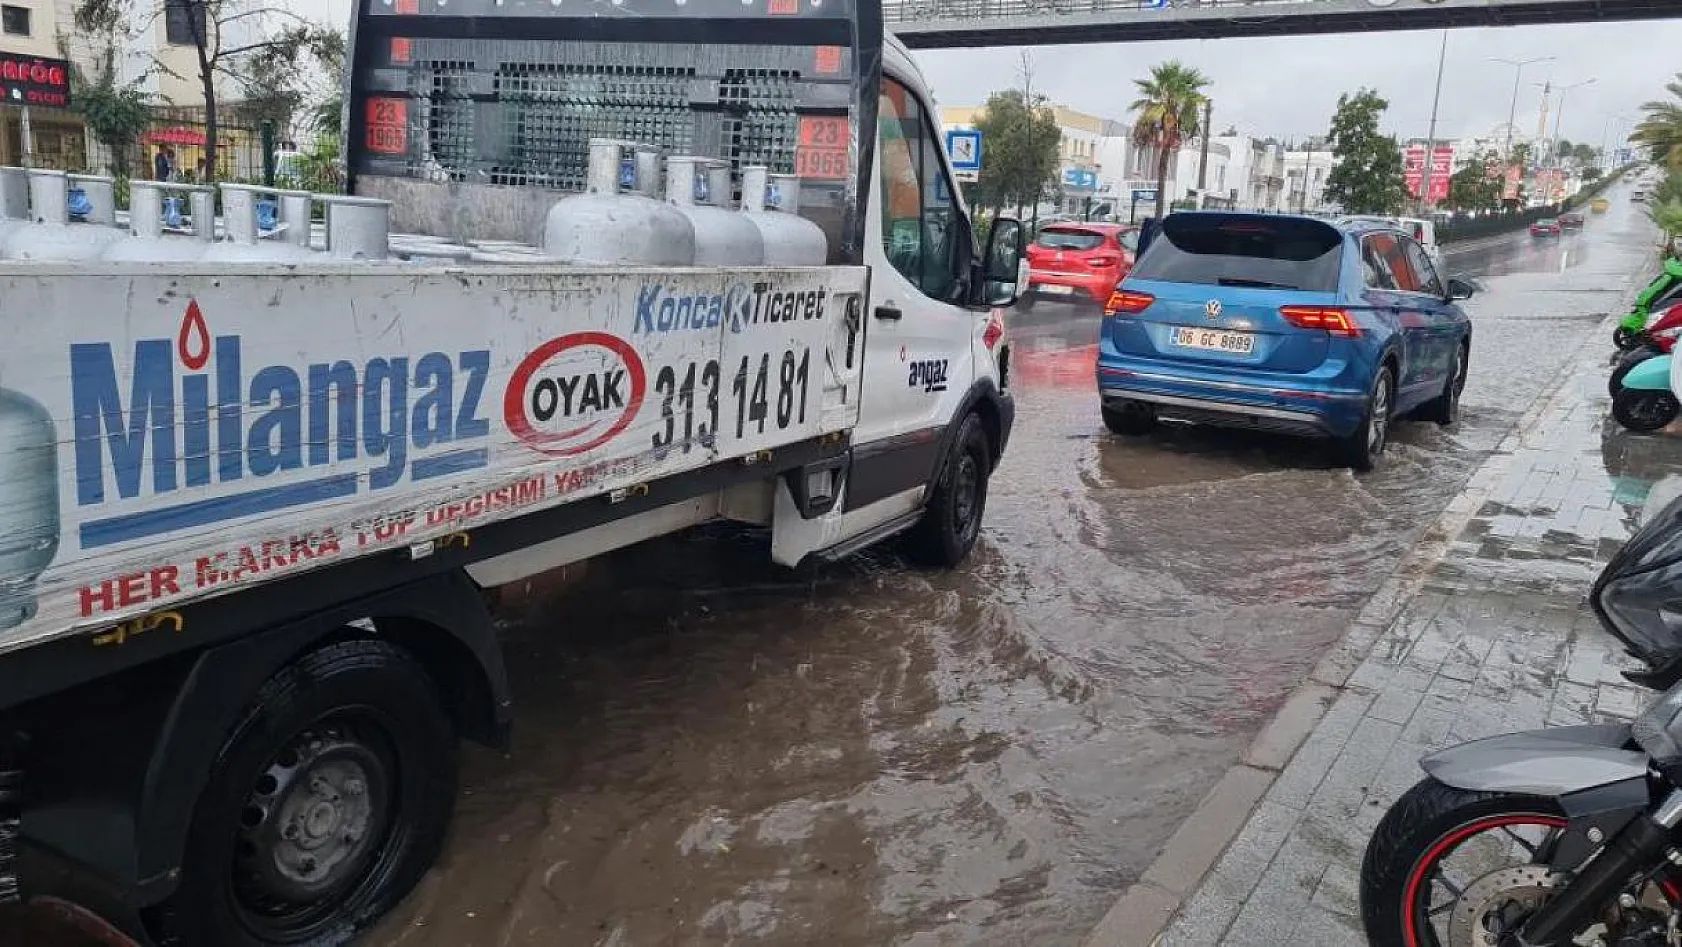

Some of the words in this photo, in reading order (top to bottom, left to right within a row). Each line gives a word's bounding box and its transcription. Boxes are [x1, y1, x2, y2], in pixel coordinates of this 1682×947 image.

[374, 102, 398, 122] 23
[812, 120, 838, 143] 23
[799, 151, 847, 175] 1965
[633, 282, 722, 335] Konca
[752, 282, 826, 324] Ticaret
[1180, 329, 1194, 344] 06
[69, 333, 490, 507] Milangaz
[532, 368, 625, 421] OYAK
[651, 359, 719, 454] 313
[733, 352, 769, 440] 14
[777, 346, 810, 430] 81
[77, 564, 180, 617] HER
[194, 526, 341, 588] MARKA
